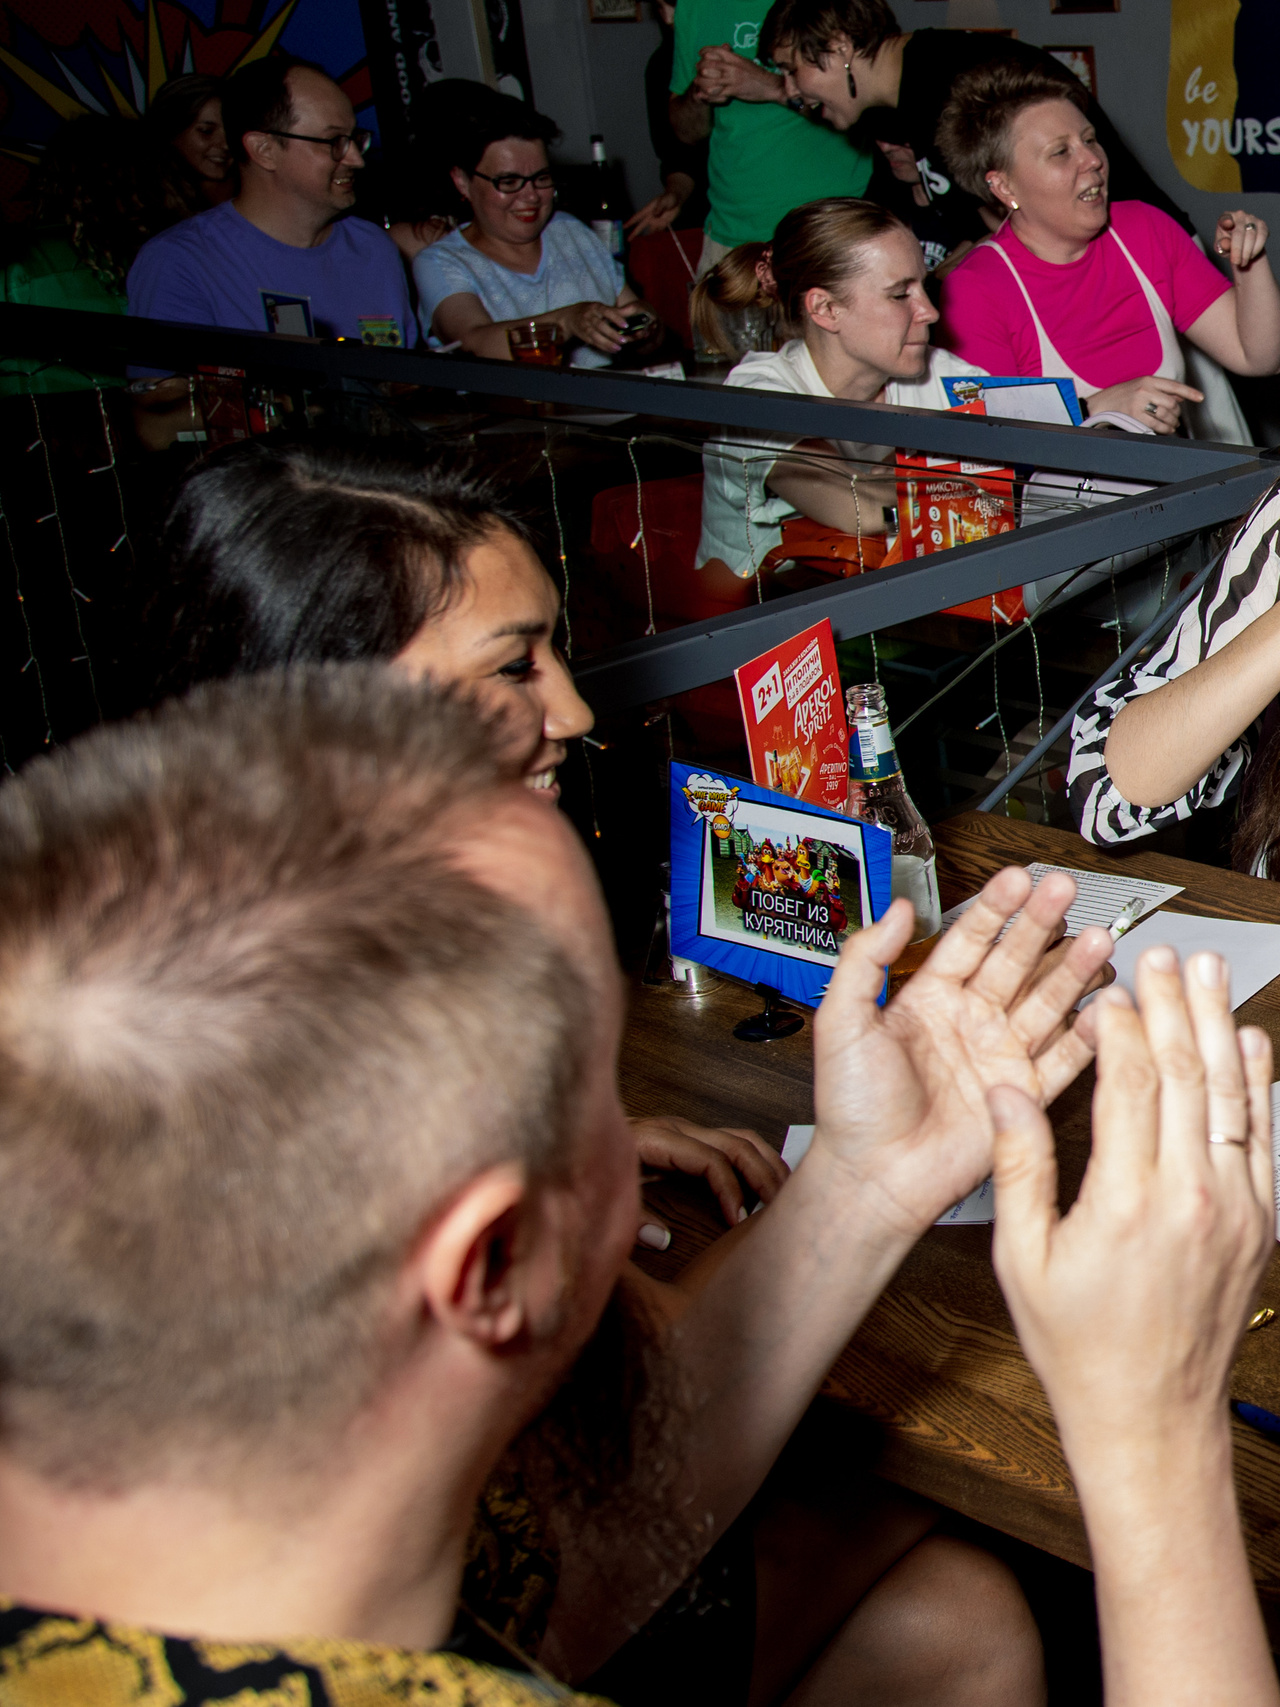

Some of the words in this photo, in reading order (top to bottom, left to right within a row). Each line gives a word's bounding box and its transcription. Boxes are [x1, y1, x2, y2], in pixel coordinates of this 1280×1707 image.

[394, 51, 413, 122] OOD
[1184, 66, 1219, 104] be
[786, 679, 792, 693] И
[792, 650, 820, 687] ПОЛУЧИ
[799, 666, 821, 690] ПОДАРОК
[758, 674, 779, 711] 2+1
[794, 674, 837, 739] APEROL
[820, 762, 848, 775] APERITIVO
[693, 790, 708, 800] ONE
[708, 791, 729, 801] MORE
[826, 781, 839, 791] 1919
[697, 800, 727, 814] GAME
[713, 823, 730, 832] OMG!
[751, 890, 804, 917] ПОБЕГ
[807, 903, 830, 924] ИЗ
[744, 911, 837, 950] КУРЯТНИКА
